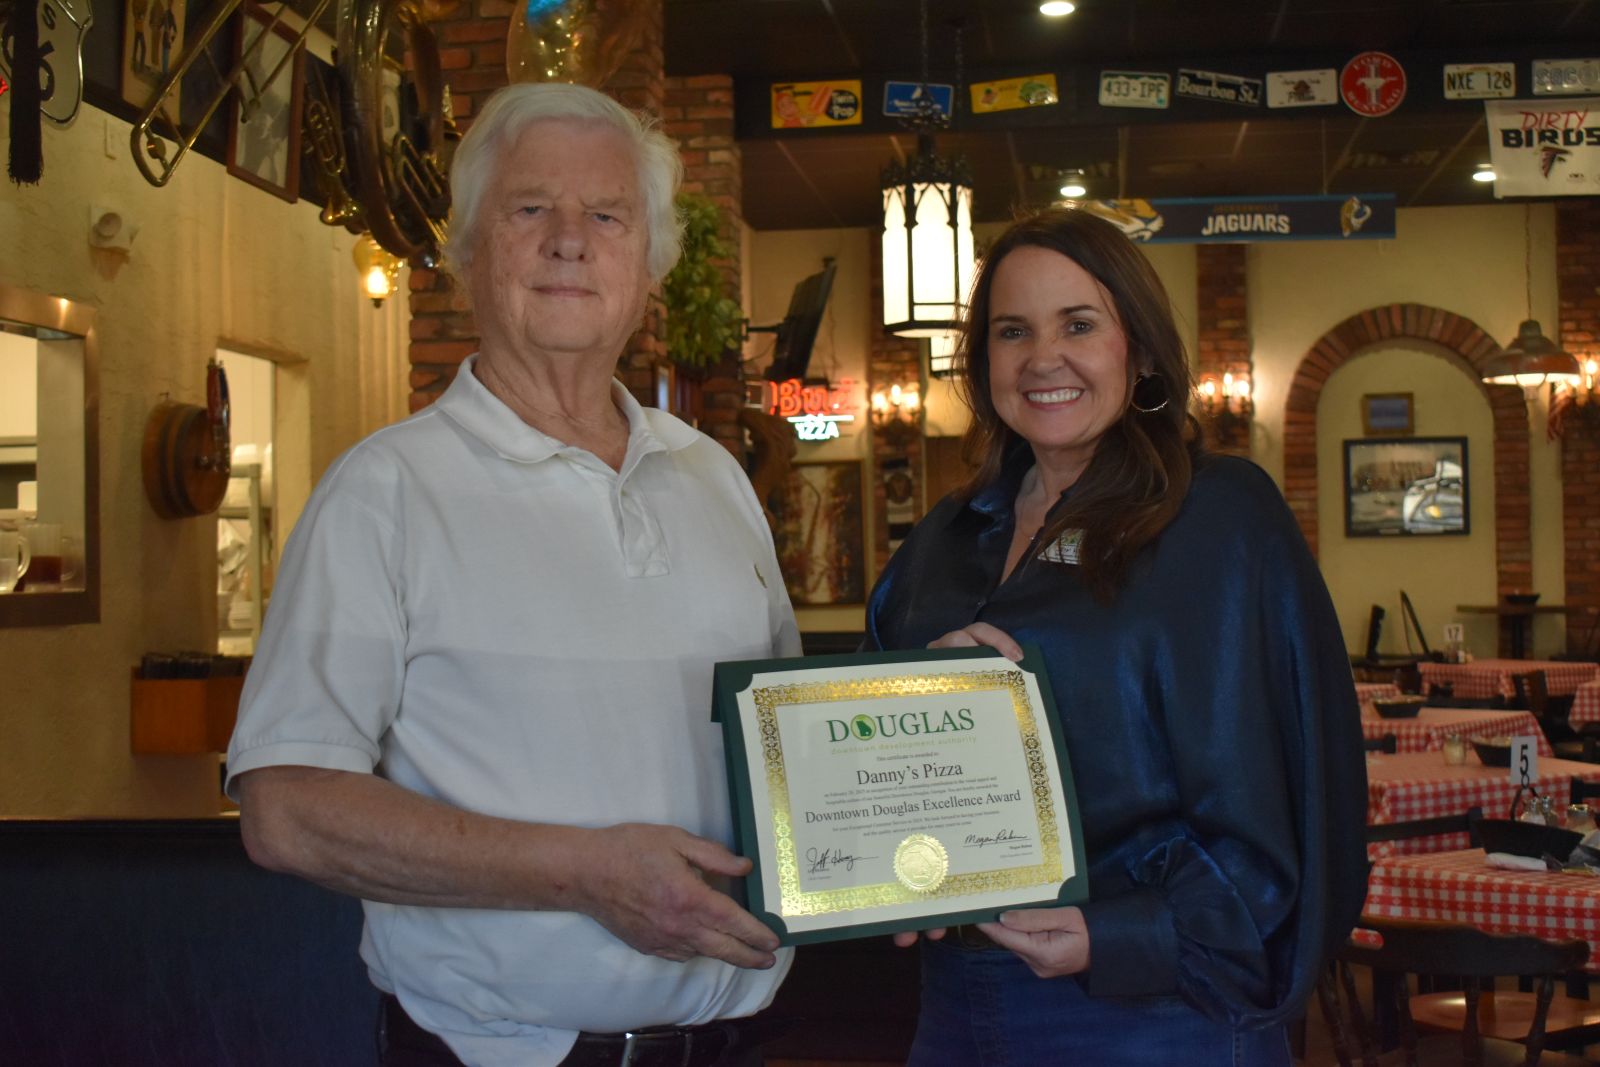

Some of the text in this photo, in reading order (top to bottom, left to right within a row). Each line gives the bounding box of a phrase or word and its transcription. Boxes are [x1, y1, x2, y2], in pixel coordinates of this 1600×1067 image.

[1178, 75, 1236, 100] Bourbon
[1447, 71, 1474, 91] NXE
[1486, 71, 1512, 89] 128
[1520, 106, 1590, 131] DIRTY
[1500, 127, 1600, 148] BIRDS
[1201, 213, 1291, 236] JAGUARS
[826, 708, 975, 742] DOUGLAS
[1519, 743, 1529, 776] 5
[856, 765, 919, 785] Danny's
[923, 762, 964, 778] Pizza
[805, 809, 869, 824] Downtown
[872, 801, 920, 817] Douglas
[922, 796, 983, 811] Excellence
[985, 790, 1022, 805] Award
